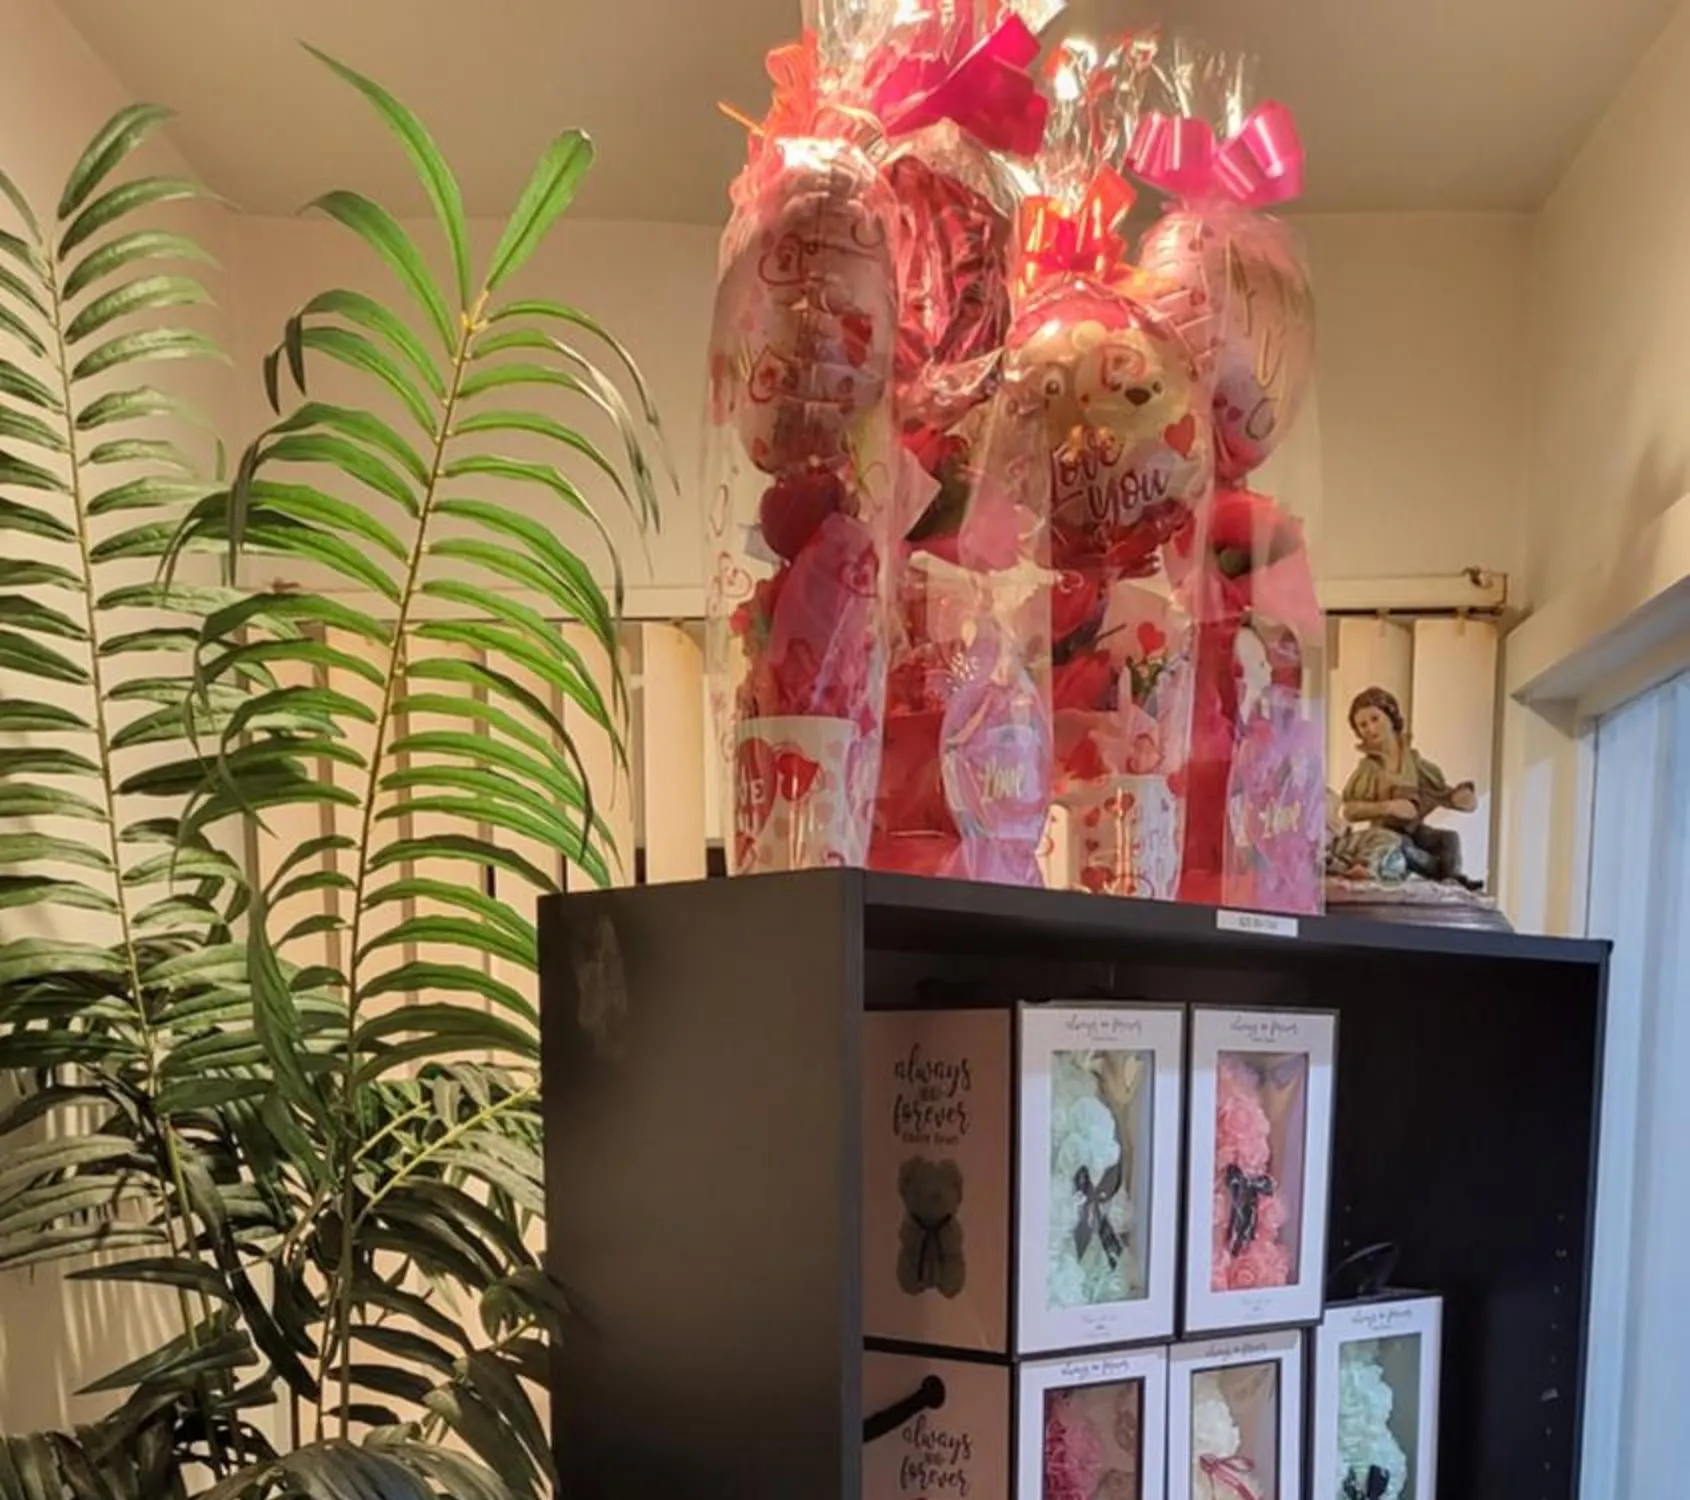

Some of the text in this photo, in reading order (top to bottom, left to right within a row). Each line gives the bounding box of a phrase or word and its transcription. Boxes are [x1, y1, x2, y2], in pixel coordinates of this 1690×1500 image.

[894, 1042, 971, 1098] always
[893, 1093, 971, 1136] forever
[902, 1413, 973, 1466] always
[900, 1454, 971, 1497] forever
